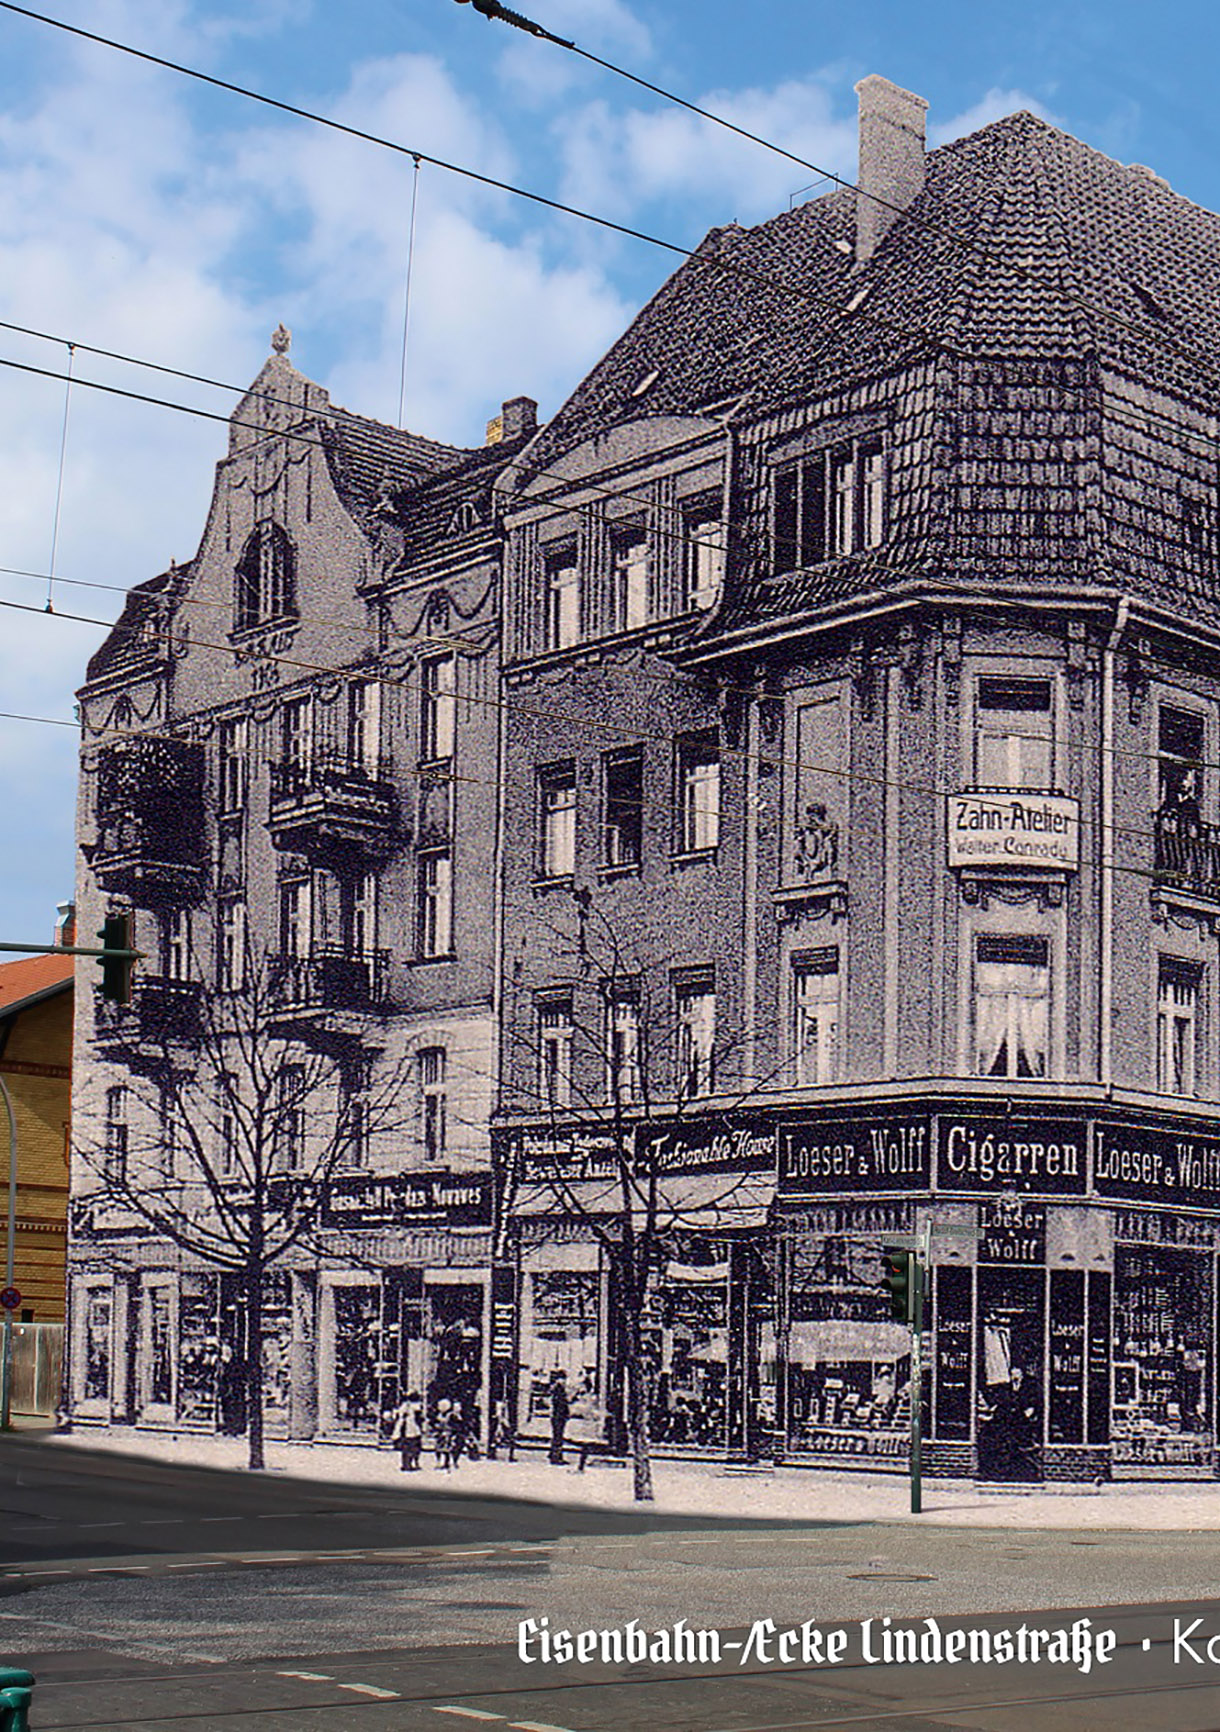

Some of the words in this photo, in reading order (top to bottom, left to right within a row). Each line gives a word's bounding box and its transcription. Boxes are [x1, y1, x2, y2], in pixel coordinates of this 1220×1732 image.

[956, 801, 1070, 834] Zahn-Atelier
[785, 1136, 855, 1178] Loeser
[857, 1156, 869, 1175] &
[870, 1127, 926, 1175] Wolff
[946, 1125, 1079, 1181] Cigarren
[1096, 1131, 1162, 1184] Loeser
[1164, 1166, 1174, 1186] &
[980, 1206, 1044, 1229] Loeser
[985, 1237, 1038, 1260] Wolff
